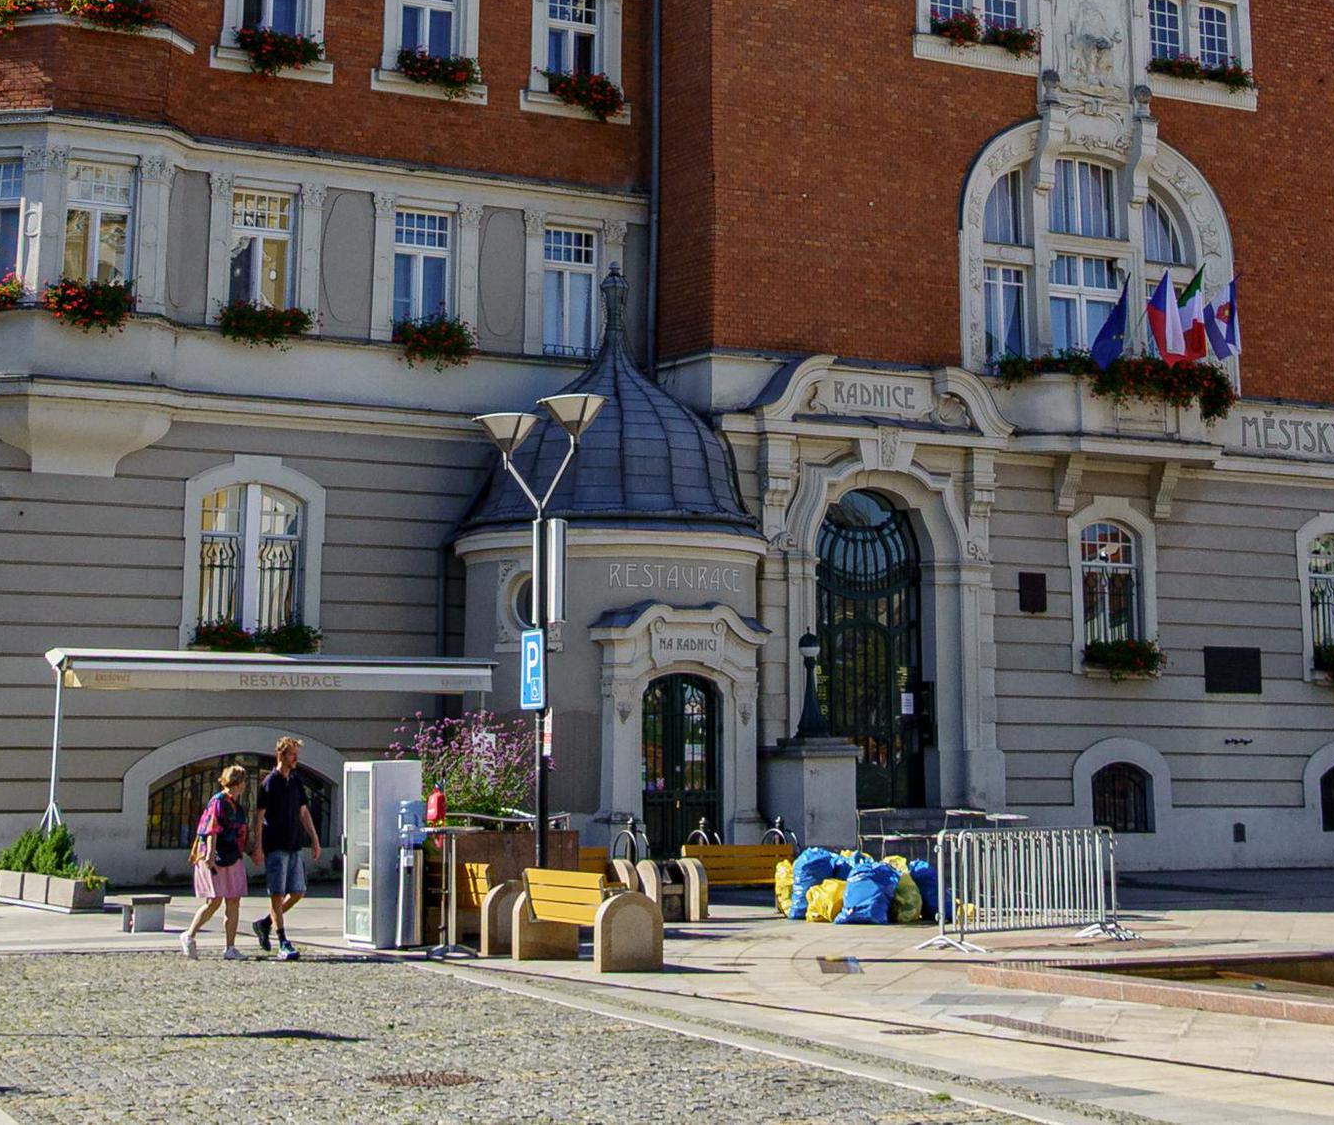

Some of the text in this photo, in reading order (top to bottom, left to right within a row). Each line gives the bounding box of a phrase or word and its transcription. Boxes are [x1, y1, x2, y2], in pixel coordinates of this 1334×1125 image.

[834, 380, 915, 410] RADNICE
[609, 563, 740, 593] RESTAURACE
[659, 638, 718, 652] NA RADNICI
[527, 641, 539, 684] P
[239, 674, 342, 688] RESTAURACE
